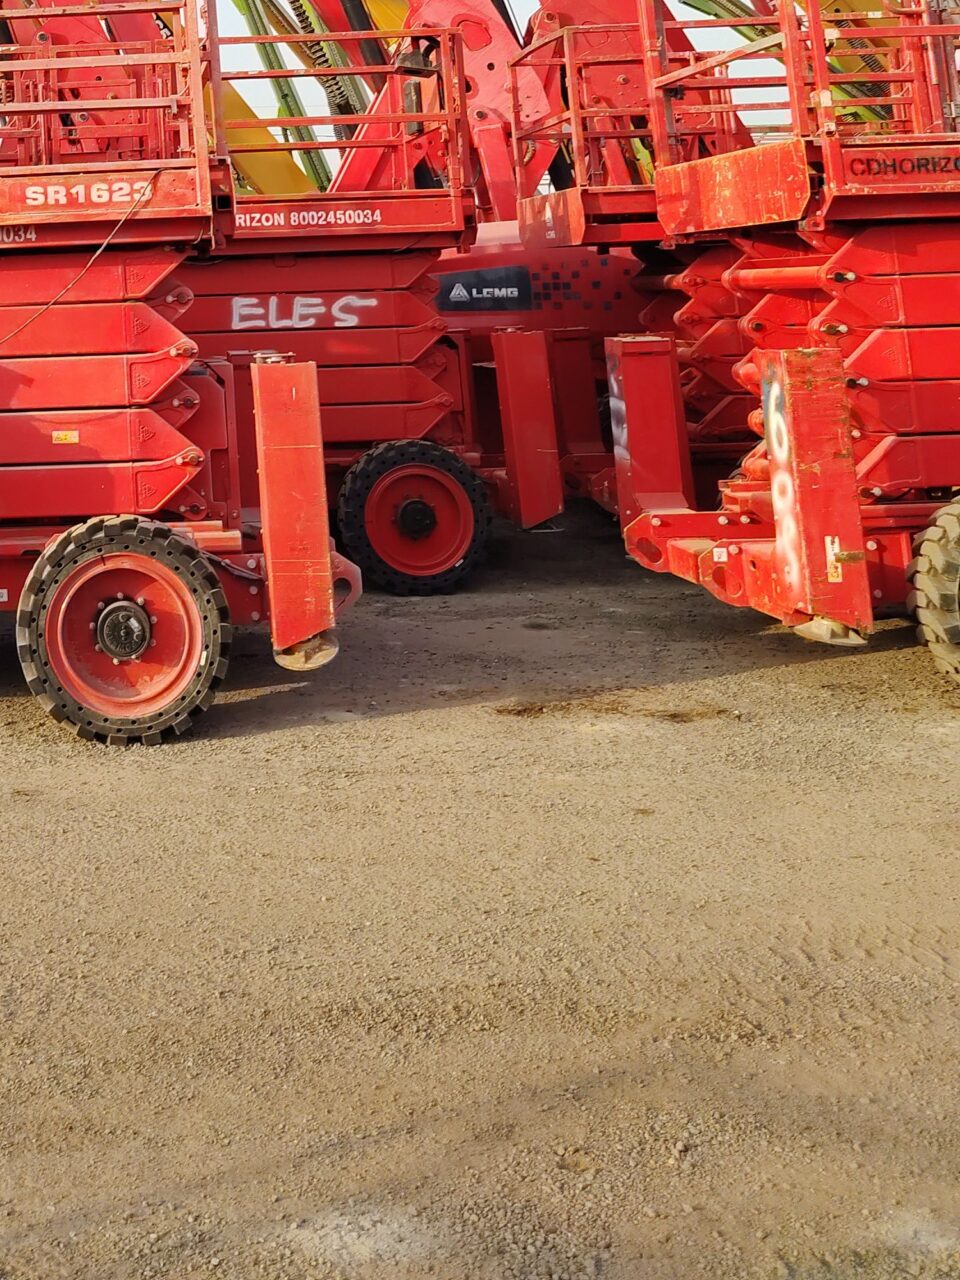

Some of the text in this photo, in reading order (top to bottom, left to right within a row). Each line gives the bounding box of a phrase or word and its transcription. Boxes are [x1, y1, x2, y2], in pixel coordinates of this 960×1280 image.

[25, 181, 153, 206] SR1623
[235, 209, 381, 227] RIZON 8002450034
